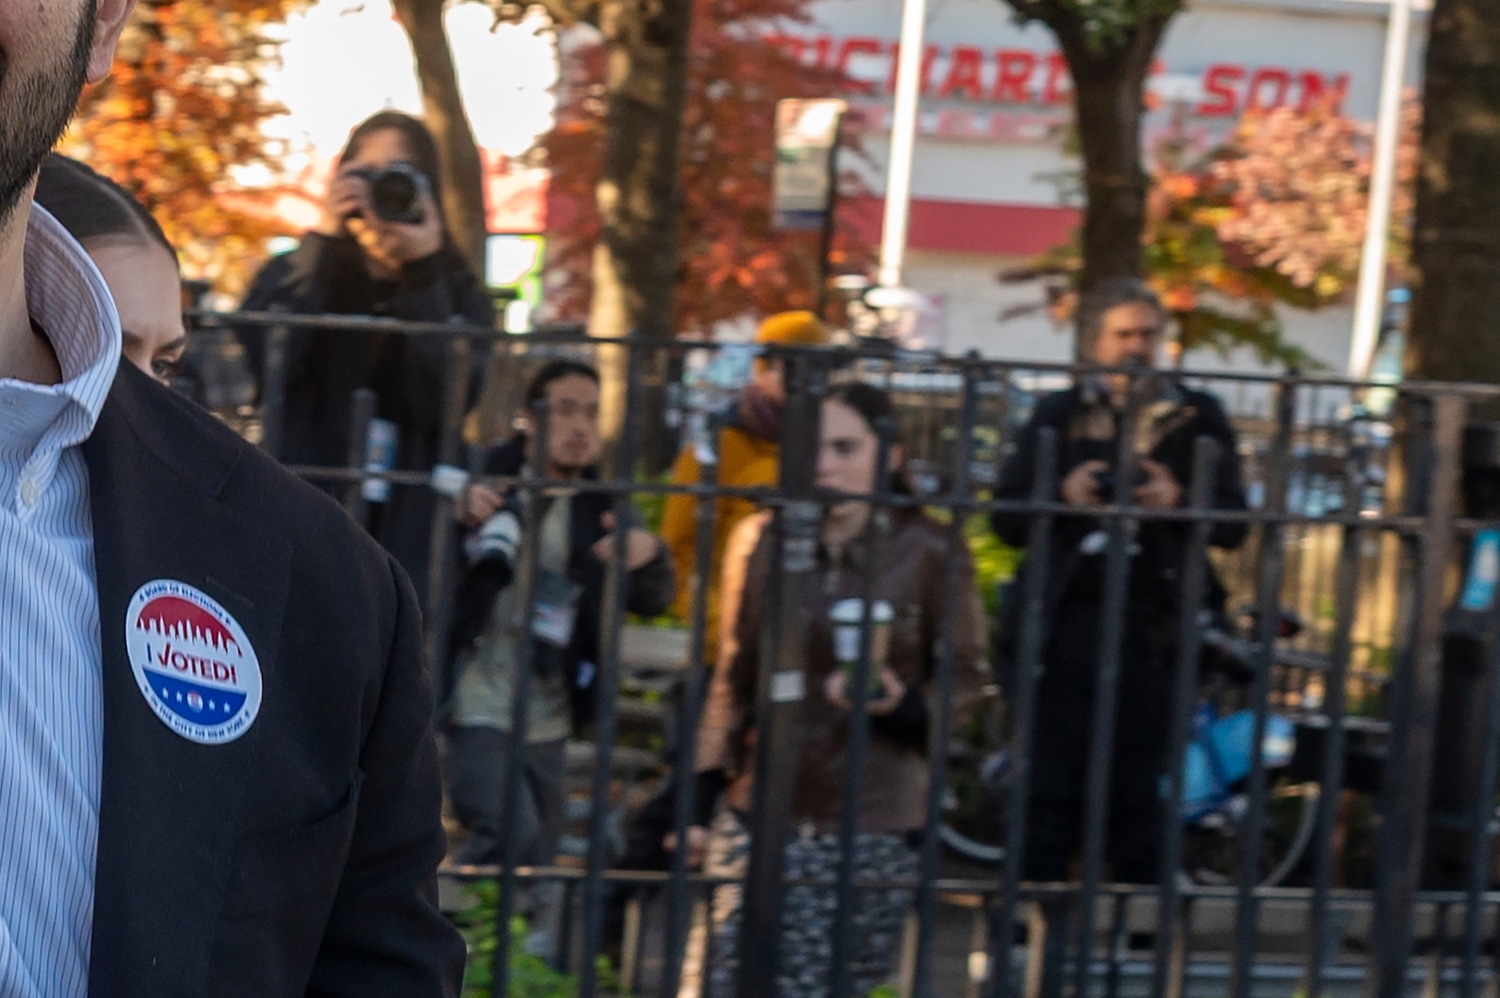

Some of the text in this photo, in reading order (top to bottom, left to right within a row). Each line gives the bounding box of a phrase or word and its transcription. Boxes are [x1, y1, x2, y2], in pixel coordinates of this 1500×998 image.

[1196, 63, 1350, 118] SON
[147, 642, 236, 685] I VOTED!
